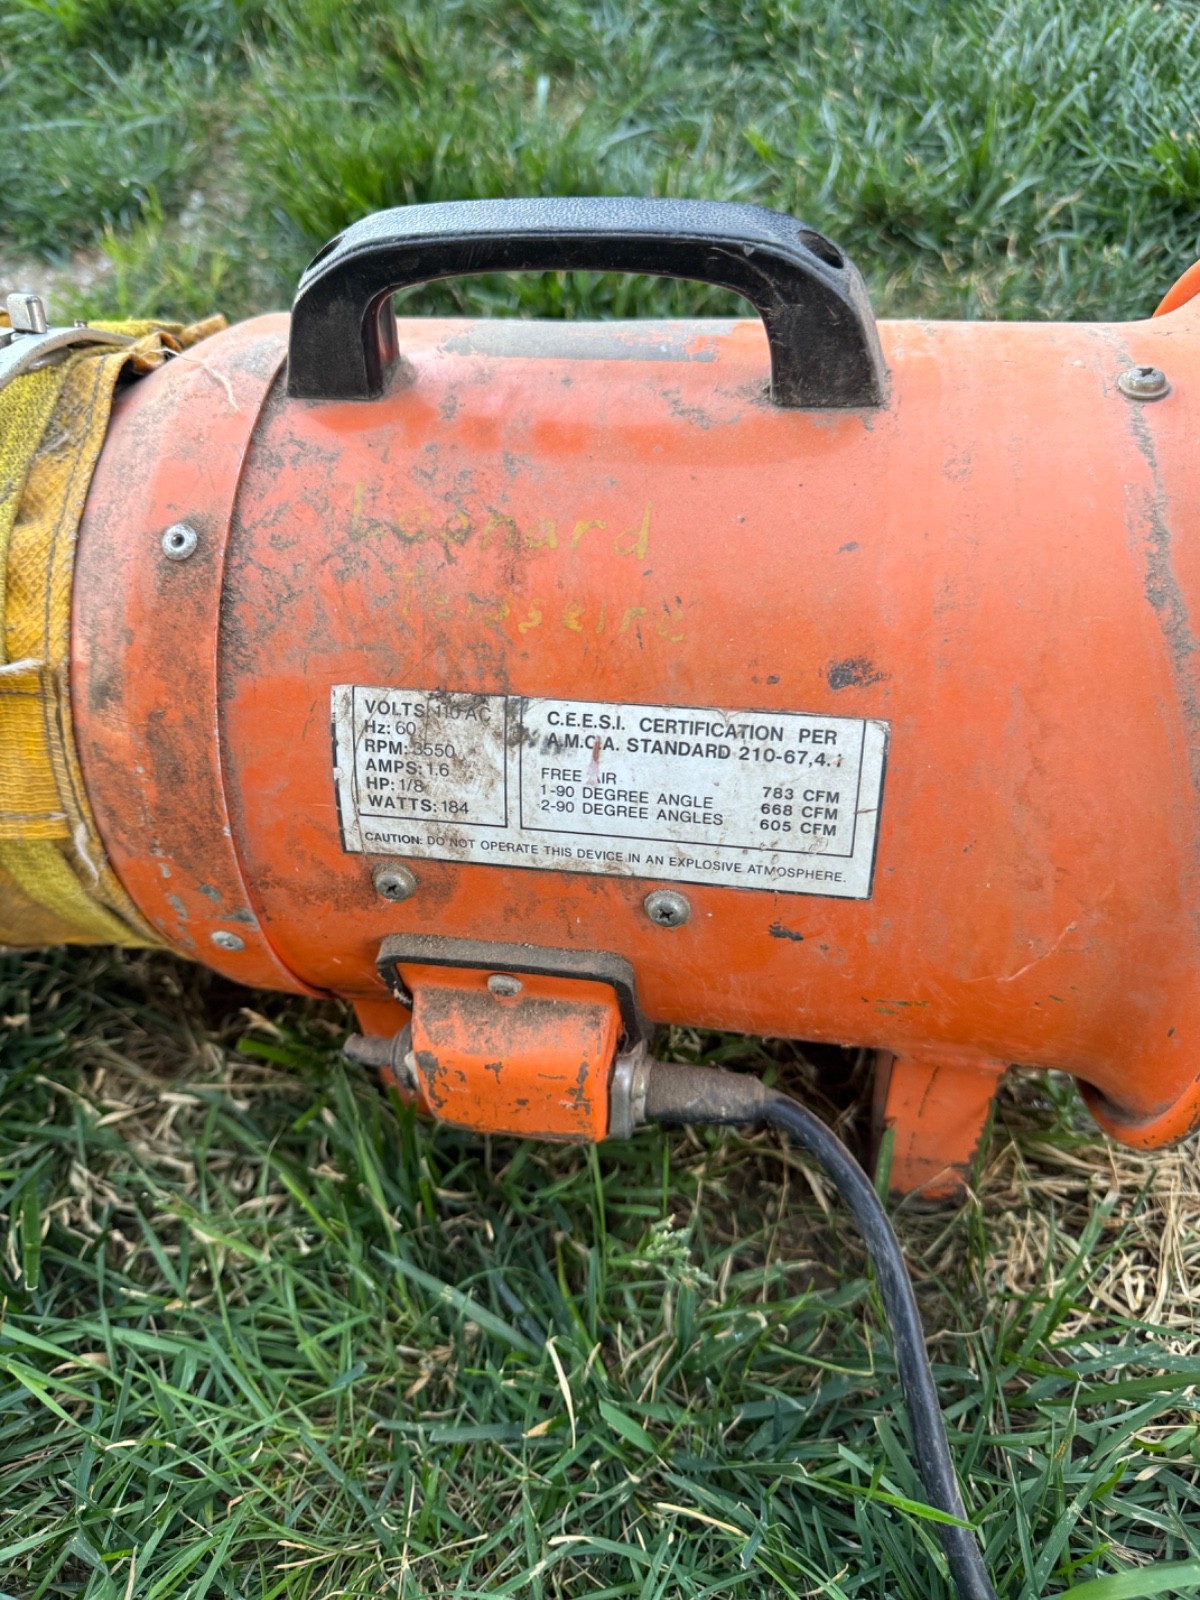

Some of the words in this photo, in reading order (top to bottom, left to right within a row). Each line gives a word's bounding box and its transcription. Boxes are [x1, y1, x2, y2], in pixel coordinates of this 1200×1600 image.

[465, 706, 491, 722] AC
[364, 719, 391, 735] Hz:
[395, 721, 417, 736] 60
[547, 711, 626, 731] C.E.E.S.I.
[639, 717, 784, 742] CERTIFICATION
[799, 728, 838, 745] PER
[364, 738, 408, 756] RPM:
[413, 742, 456, 758] 3550
[626, 738, 731, 759] STANDARD
[365, 758, 422, 775] AMPS:
[427, 762, 449, 777] 1.6
[366, 776, 395, 791] HP:
[400, 779, 424, 793] 1/8
[541, 767, 582, 782] FREE
[592, 772, 617, 785] IR
[762, 786, 794, 800] 783
[803, 789, 840, 804] CFM
[367, 794, 437, 813] WATTS:
[442, 800, 469, 815] 184
[540, 785, 575, 798] 1-90
[582, 787, 649, 804] DEGREE
[656, 793, 714, 809] ANGLE
[760, 803, 793, 816] 668
[801, 806, 838, 820] CFM
[540, 800, 575, 813] 2-90
[582, 802, 649, 819] DEGREE
[656, 809, 724, 826] ANGLES
[759, 819, 792, 832] 605
[800, 822, 837, 836] CFM
[364, 832, 423, 845] CAUTION:
[427, 835, 445, 847] DO
[450, 839, 476, 849] NOT
[480, 840, 538, 855] OPERATE
[544, 845, 573, 858] THIS
[577, 848, 624, 862] DEVICE
[628, 853, 641, 863] IN
[645, 855, 664, 865] AN
[669, 856, 743, 873] EXPLOSIVE
[747, 864, 847, 883] ATMOSPHERE.
